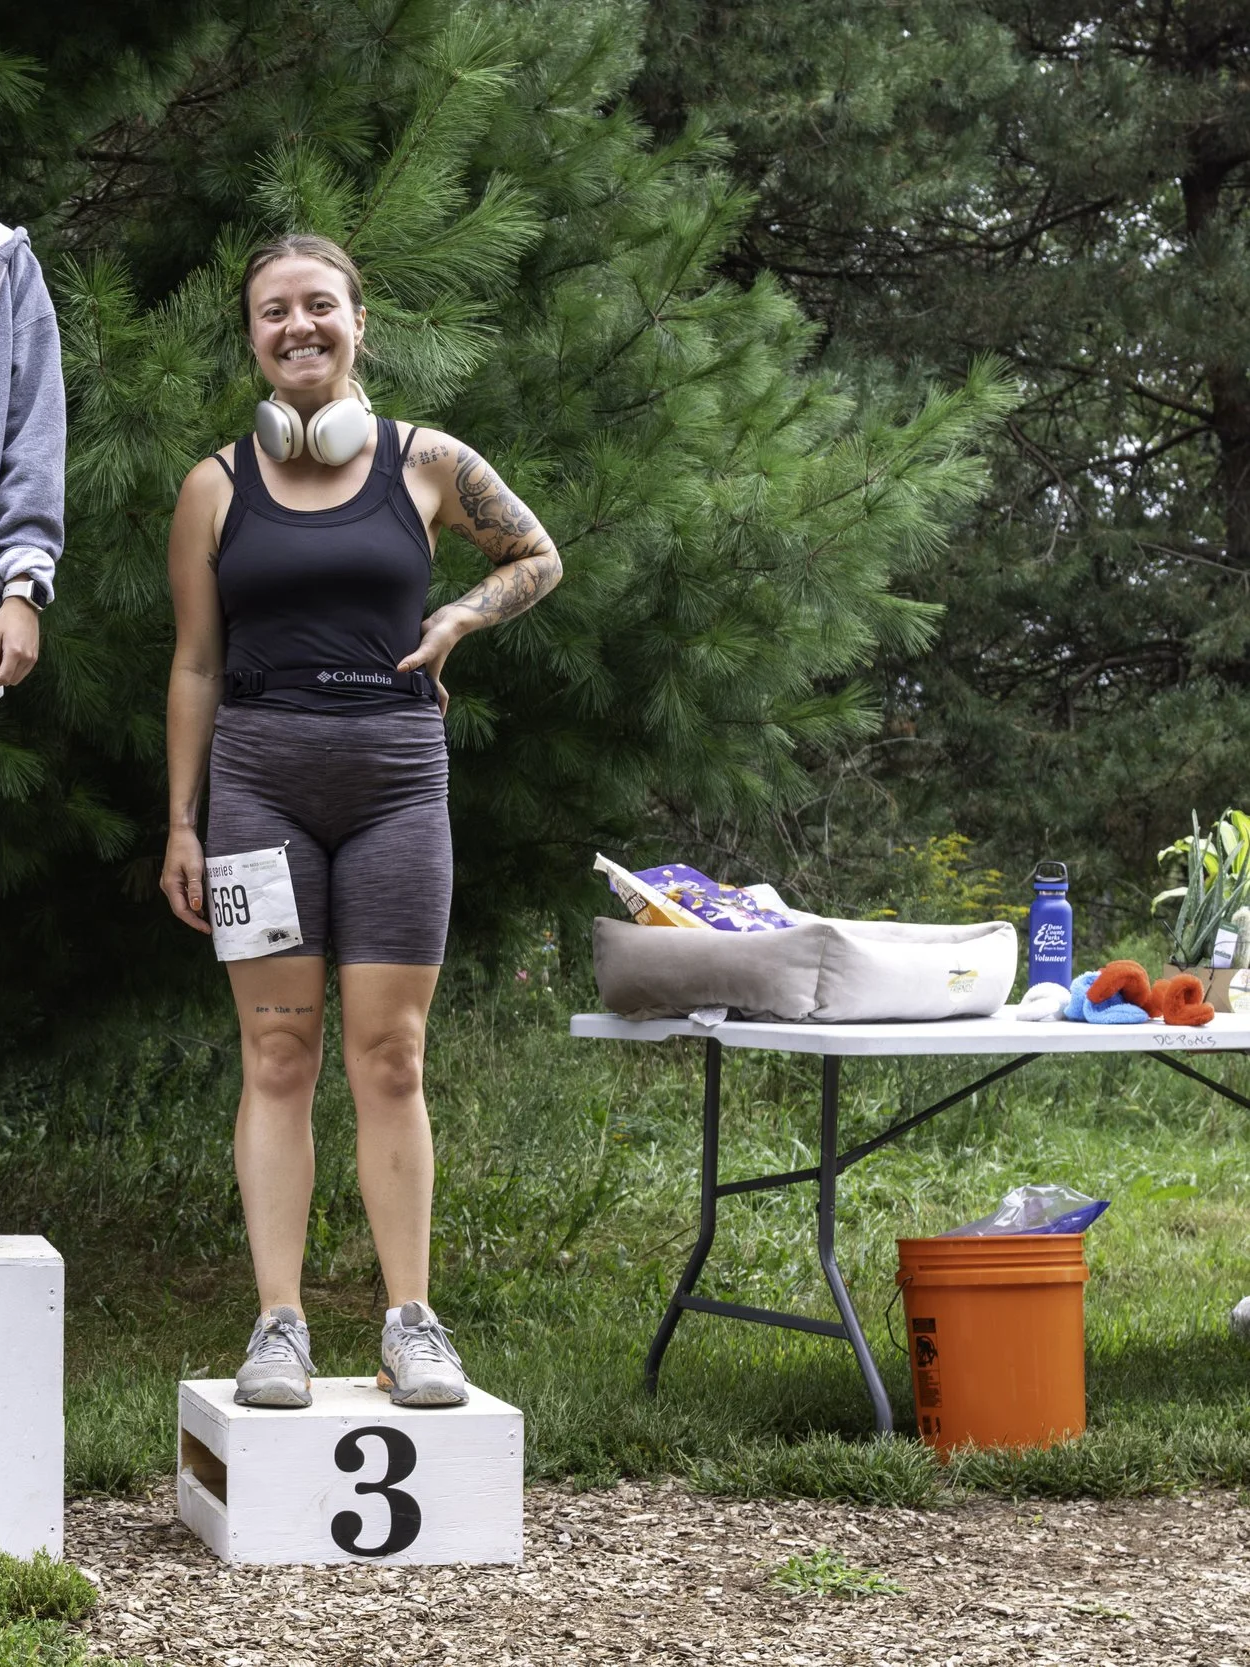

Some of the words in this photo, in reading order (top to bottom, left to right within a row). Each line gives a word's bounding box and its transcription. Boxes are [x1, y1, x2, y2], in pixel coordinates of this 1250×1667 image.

[332, 671, 392, 685] Columbia
[212, 864, 233, 878] series
[211, 885, 251, 927] 569
[1035, 954, 1067, 962] Volunteer
[275, 1005, 291, 1013] the
[1153, 1034, 1173, 1046] DC
[332, 1426, 420, 1557] 3
